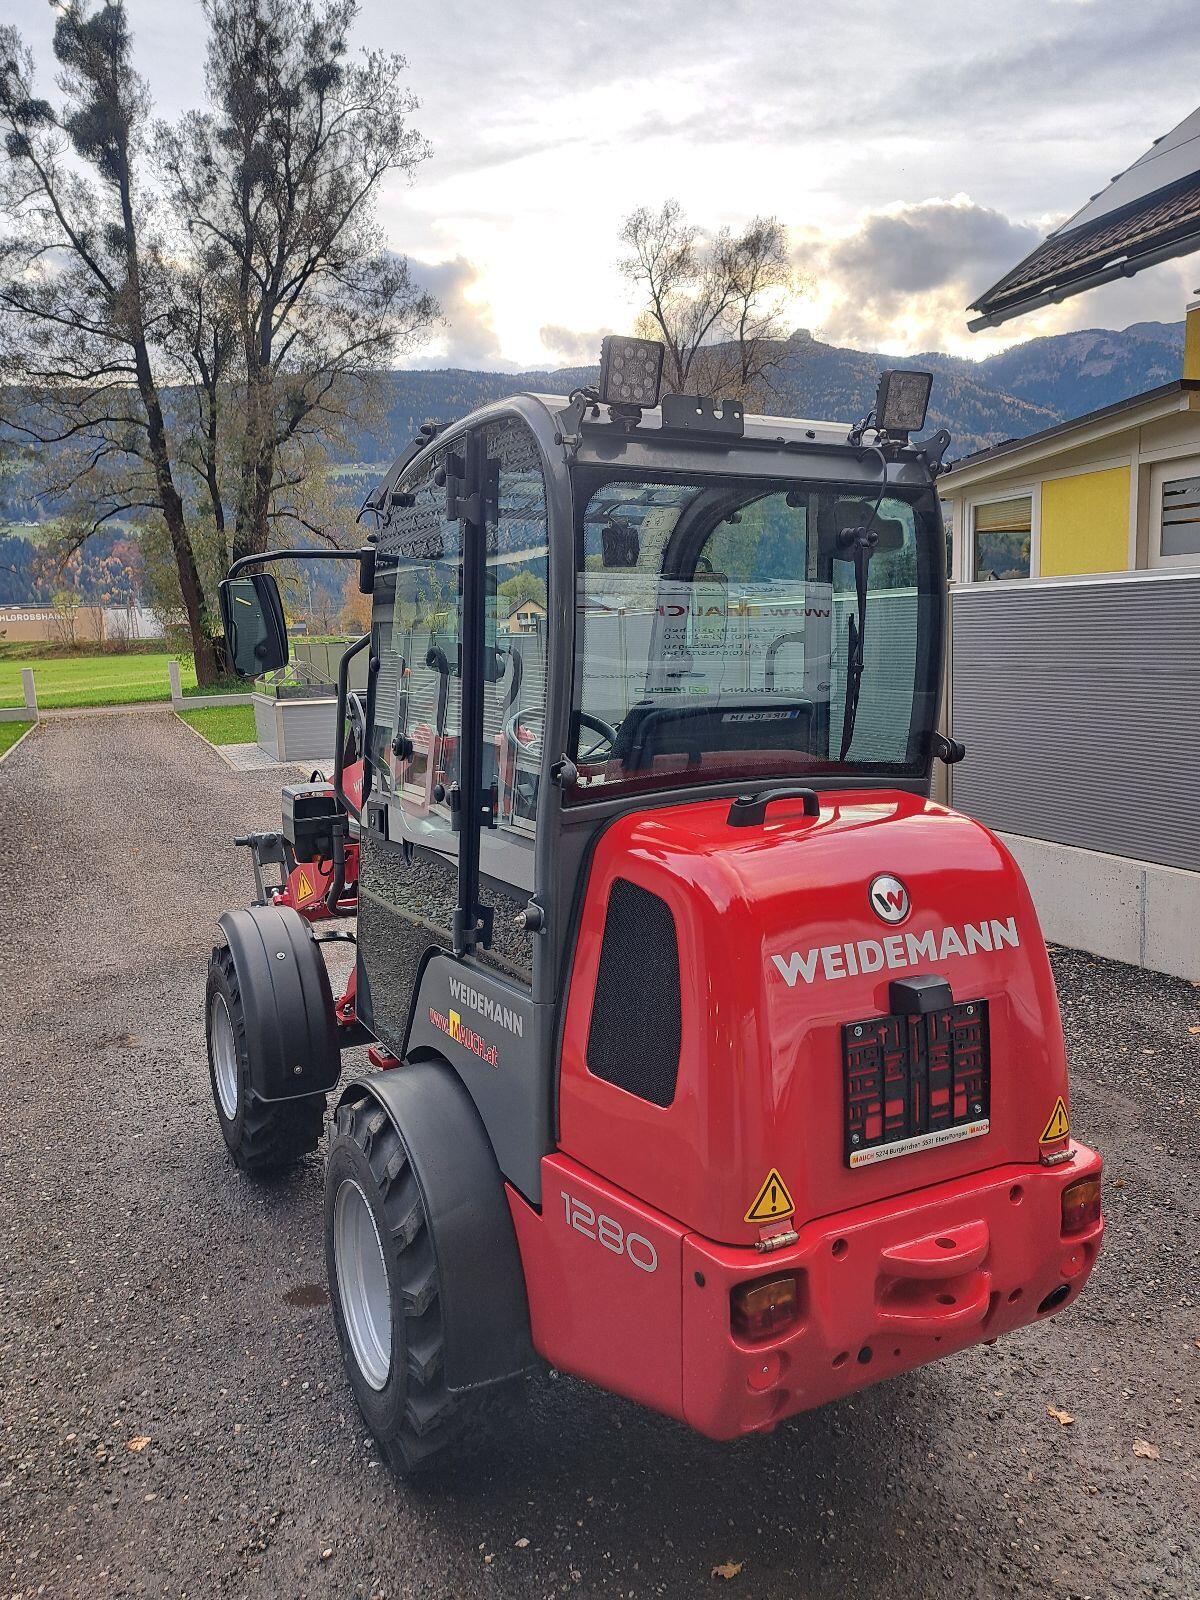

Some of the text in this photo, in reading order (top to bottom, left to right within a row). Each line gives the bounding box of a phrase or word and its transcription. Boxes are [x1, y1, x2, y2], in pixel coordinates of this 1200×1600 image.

[771, 917, 1020, 987] WEIDEMANN
[428, 1007, 498, 1068] www.MAUCH.at
[448, 976, 523, 1038] WEIDEMANN
[851, 1152, 875, 1164] MAUCH
[560, 1190, 658, 1273] 1280
